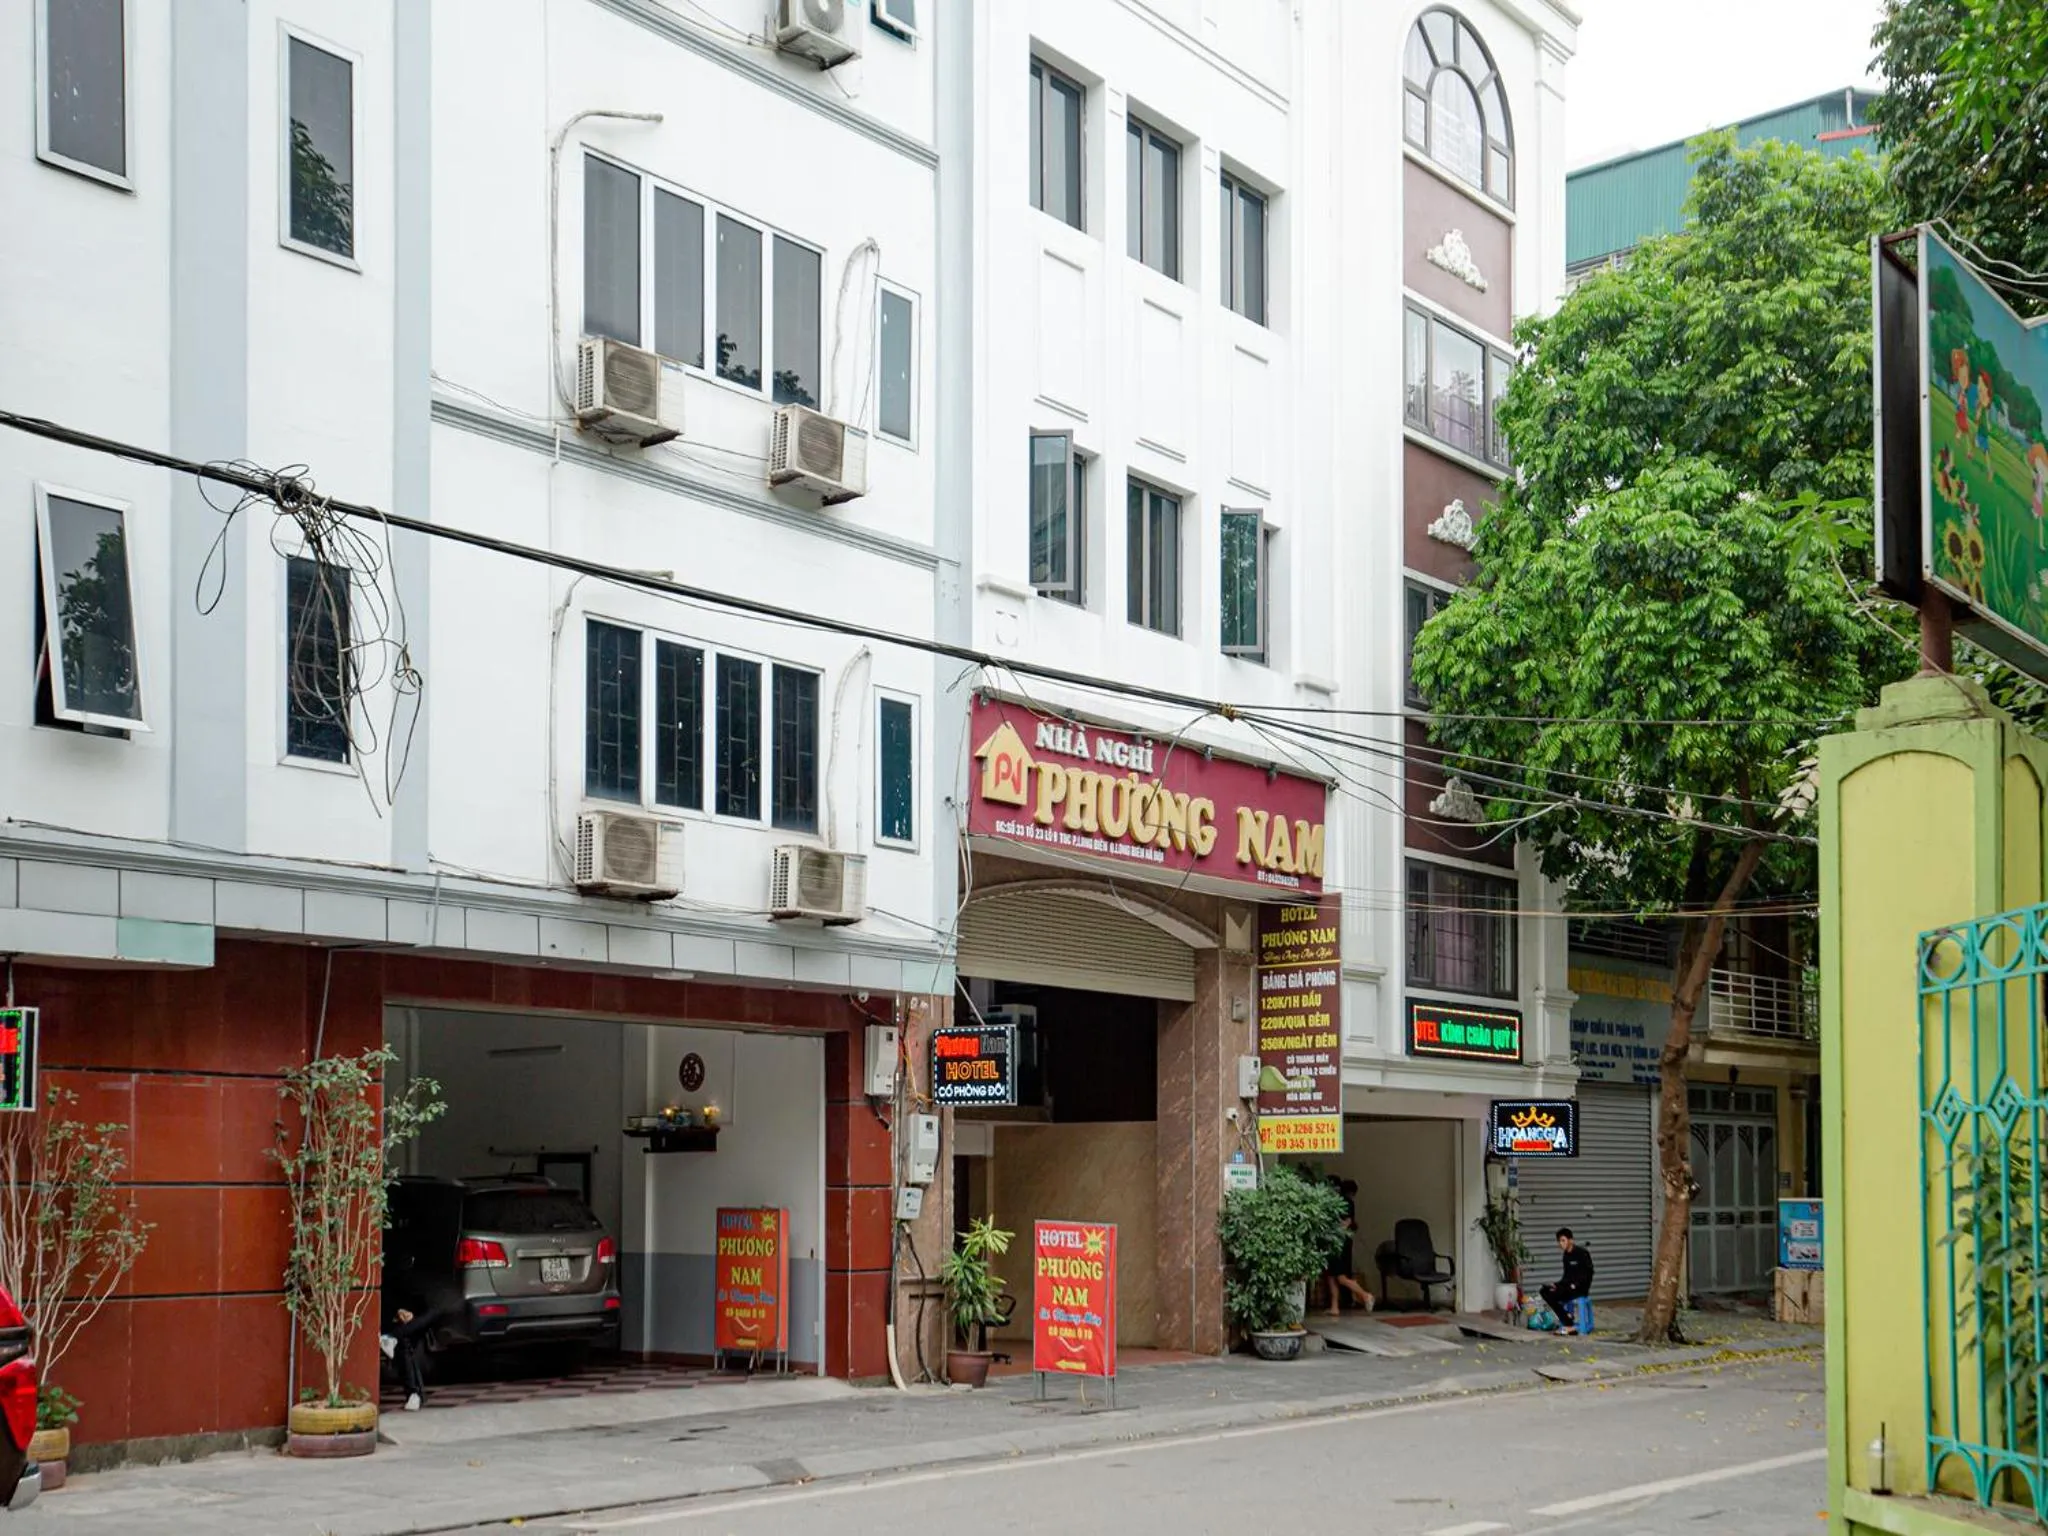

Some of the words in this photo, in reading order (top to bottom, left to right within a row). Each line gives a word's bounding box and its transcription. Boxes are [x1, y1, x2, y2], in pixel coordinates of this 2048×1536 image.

[1035, 721, 1090, 759] NHÀ
[1095, 735, 1153, 773] NGHỈ
[1033, 762, 1218, 856] PHƯƠNG
[1237, 806, 1324, 878] NAM
[1281, 907, 1317, 922] HOTEL
[1262, 929, 1308, 948] PHƯƠNG
[1310, 927, 1336, 944] NAM
[1262, 970, 1287, 990] BẢNG
[946, 1060, 999, 1080] HOTEL
[938, 1083, 953, 1098] CÓ
[954, 1083, 986, 1097] PHÒNG
[988, 1082, 1005, 1097] ĐÔI
[1276, 1123, 1291, 1134] 024
[1039, 1229, 1083, 1248] HOTEL
[731, 1267, 762, 1286] NAM
[1038, 1256, 1104, 1281] PHƯƠNG
[1052, 1285, 1088, 1307] NAM
